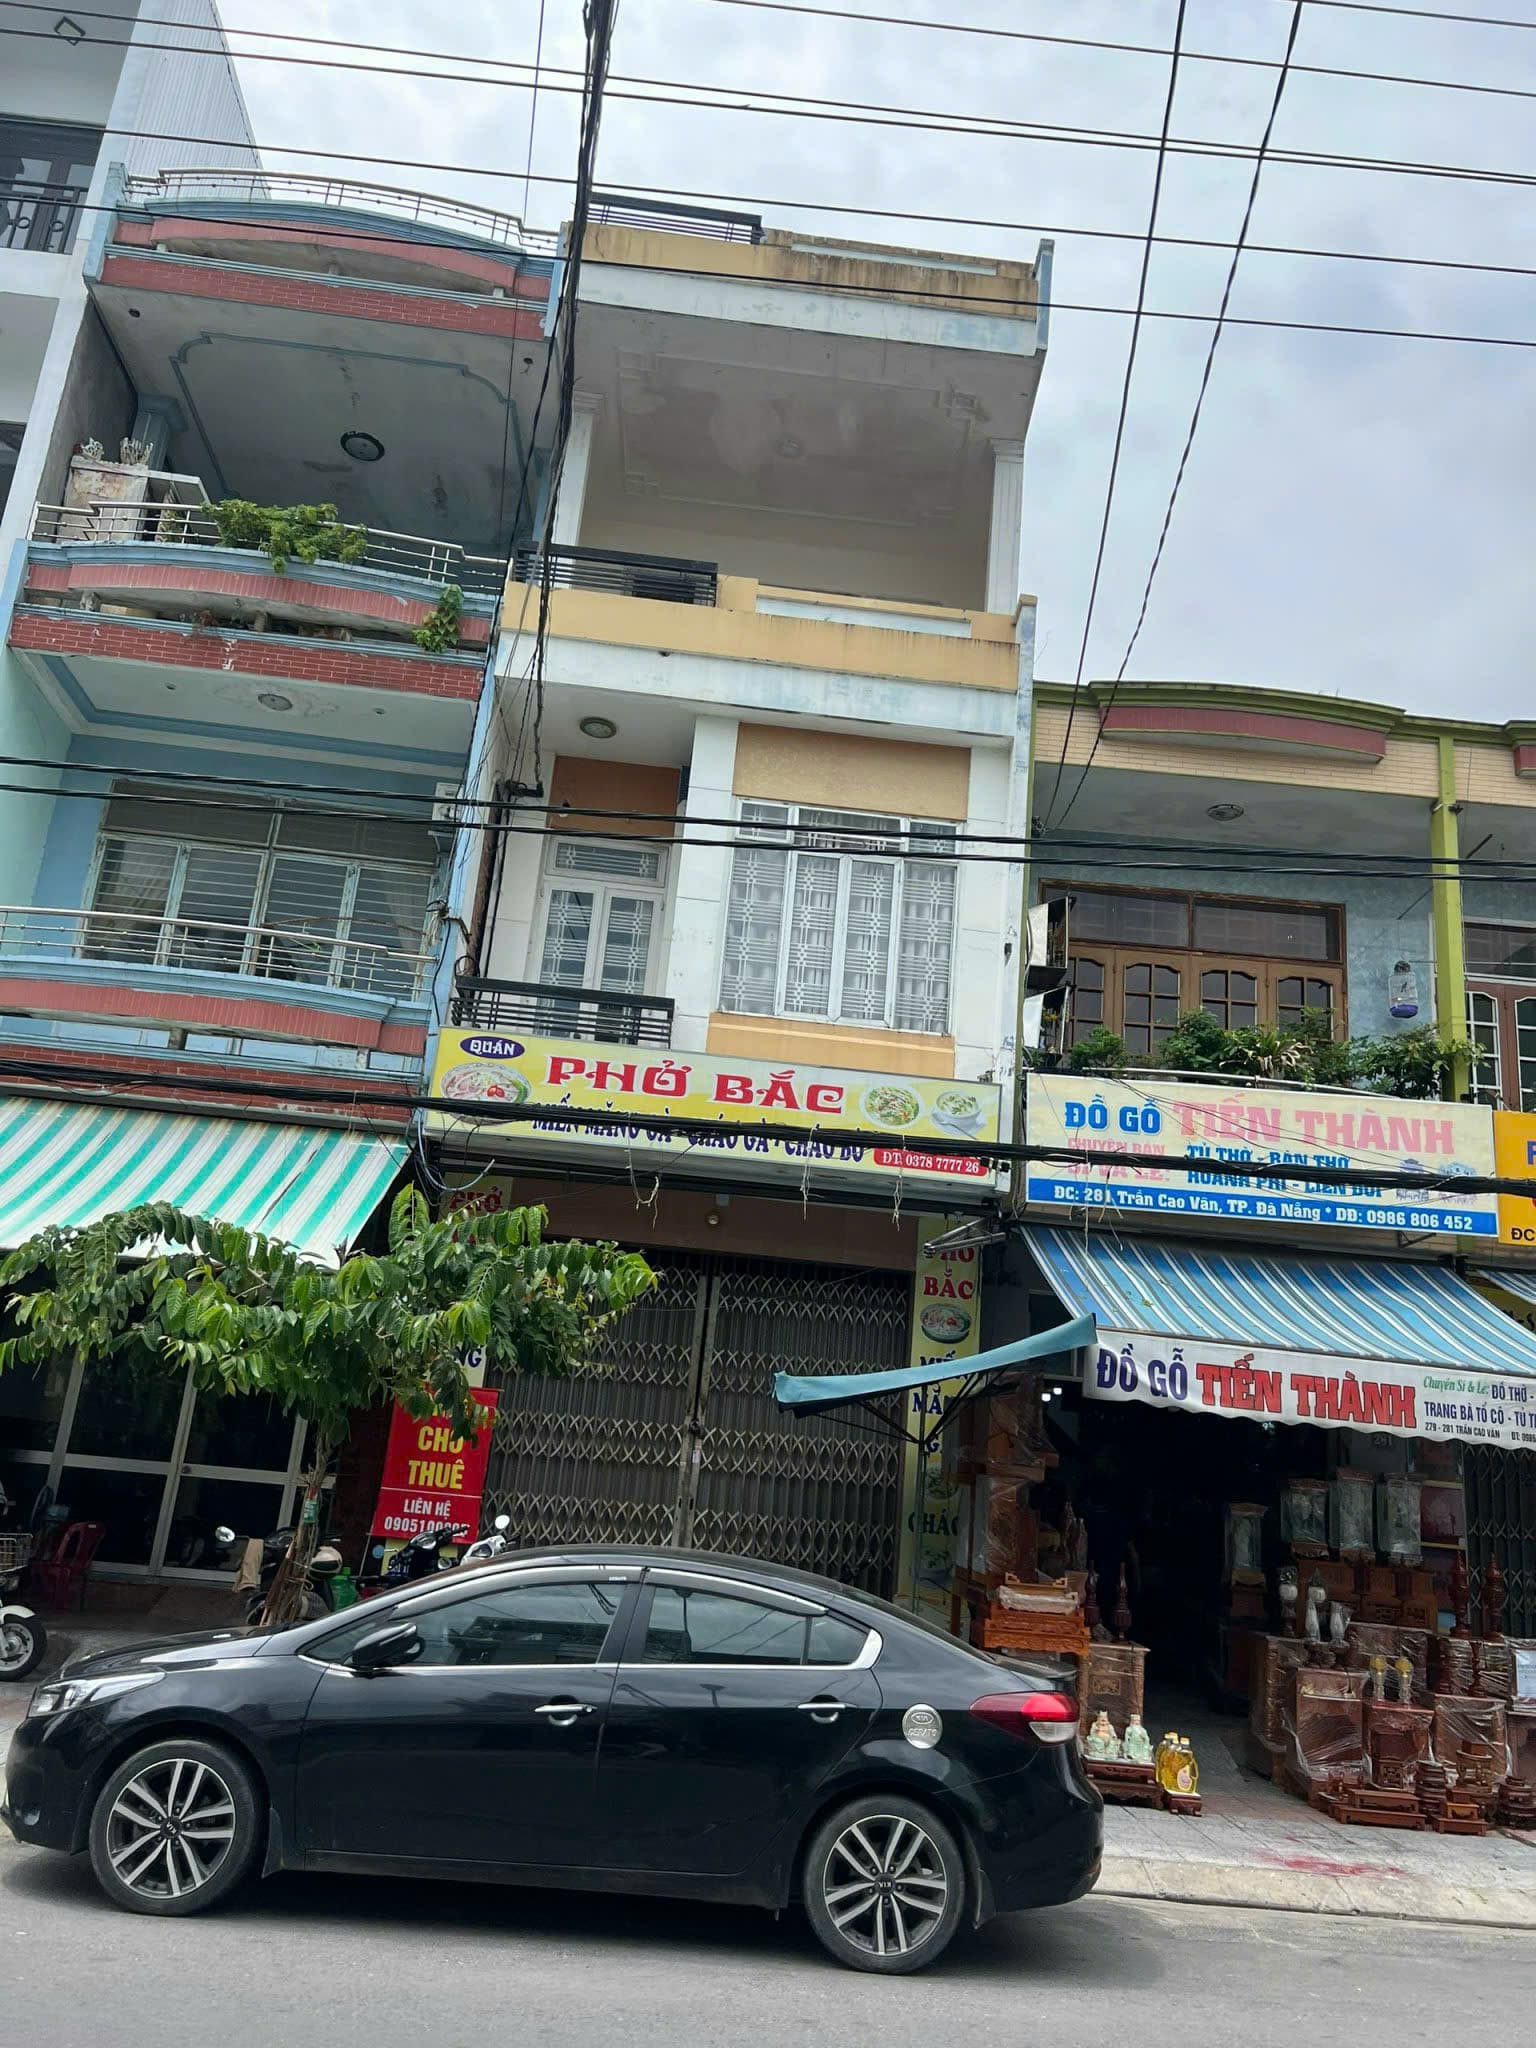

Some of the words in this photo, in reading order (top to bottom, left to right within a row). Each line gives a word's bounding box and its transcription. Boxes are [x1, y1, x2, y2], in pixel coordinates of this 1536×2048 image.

[470, 1038, 515, 1056] QUÁN
[547, 1056, 692, 1097] PHỞ
[714, 1069, 844, 1114] BẮC
[1064, 1094, 1108, 1130] ĐỒ
[1119, 1097, 1161, 1134] GỖ
[1173, 1093, 1281, 1142] TIẾN
[1295, 1108, 1456, 1154] THÀNH
[905, 1155, 933, 1169] 0378
[936, 1158, 962, 1171] 7777
[965, 1161, 980, 1174] 26
[1054, 1185, 1079, 1200] ĐC:
[1117, 1189, 1153, 1206] Trần
[1158, 1194, 1185, 1208] Cao
[1190, 1196, 1222, 1214] Vân,
[1227, 1199, 1252, 1214] TP.
[1256, 1202, 1276, 1216] Đà
[1281, 1202, 1320, 1221] Nẵng
[1336, 1207, 1362, 1221] DĐ:
[1366, 1211, 1406, 1226] 0986
[1410, 1213, 1439, 1228] 806
[1444, 1215, 1473, 1230] 452
[1097, 1343, 1138, 1392] ĐỒ
[1147, 1347, 1188, 1400] GỖ
[1196, 1353, 1282, 1413] TIẾN
[1290, 1371, 1417, 1428] THÀNH
[1424, 1401, 1457, 1420] TRANG
[1460, 1402, 1473, 1421] BÀ
[1490, 1406, 1504, 1425] CÔ
[417, 1425, 464, 1454] CHO
[1442, 1423, 1454, 1433] 281
[1473, 1428, 1486, 1438] CAO
[408, 1459, 465, 1489] THUÊ
[403, 1497, 432, 1515] LIÊN
[435, 1500, 451, 1520] HỆ
